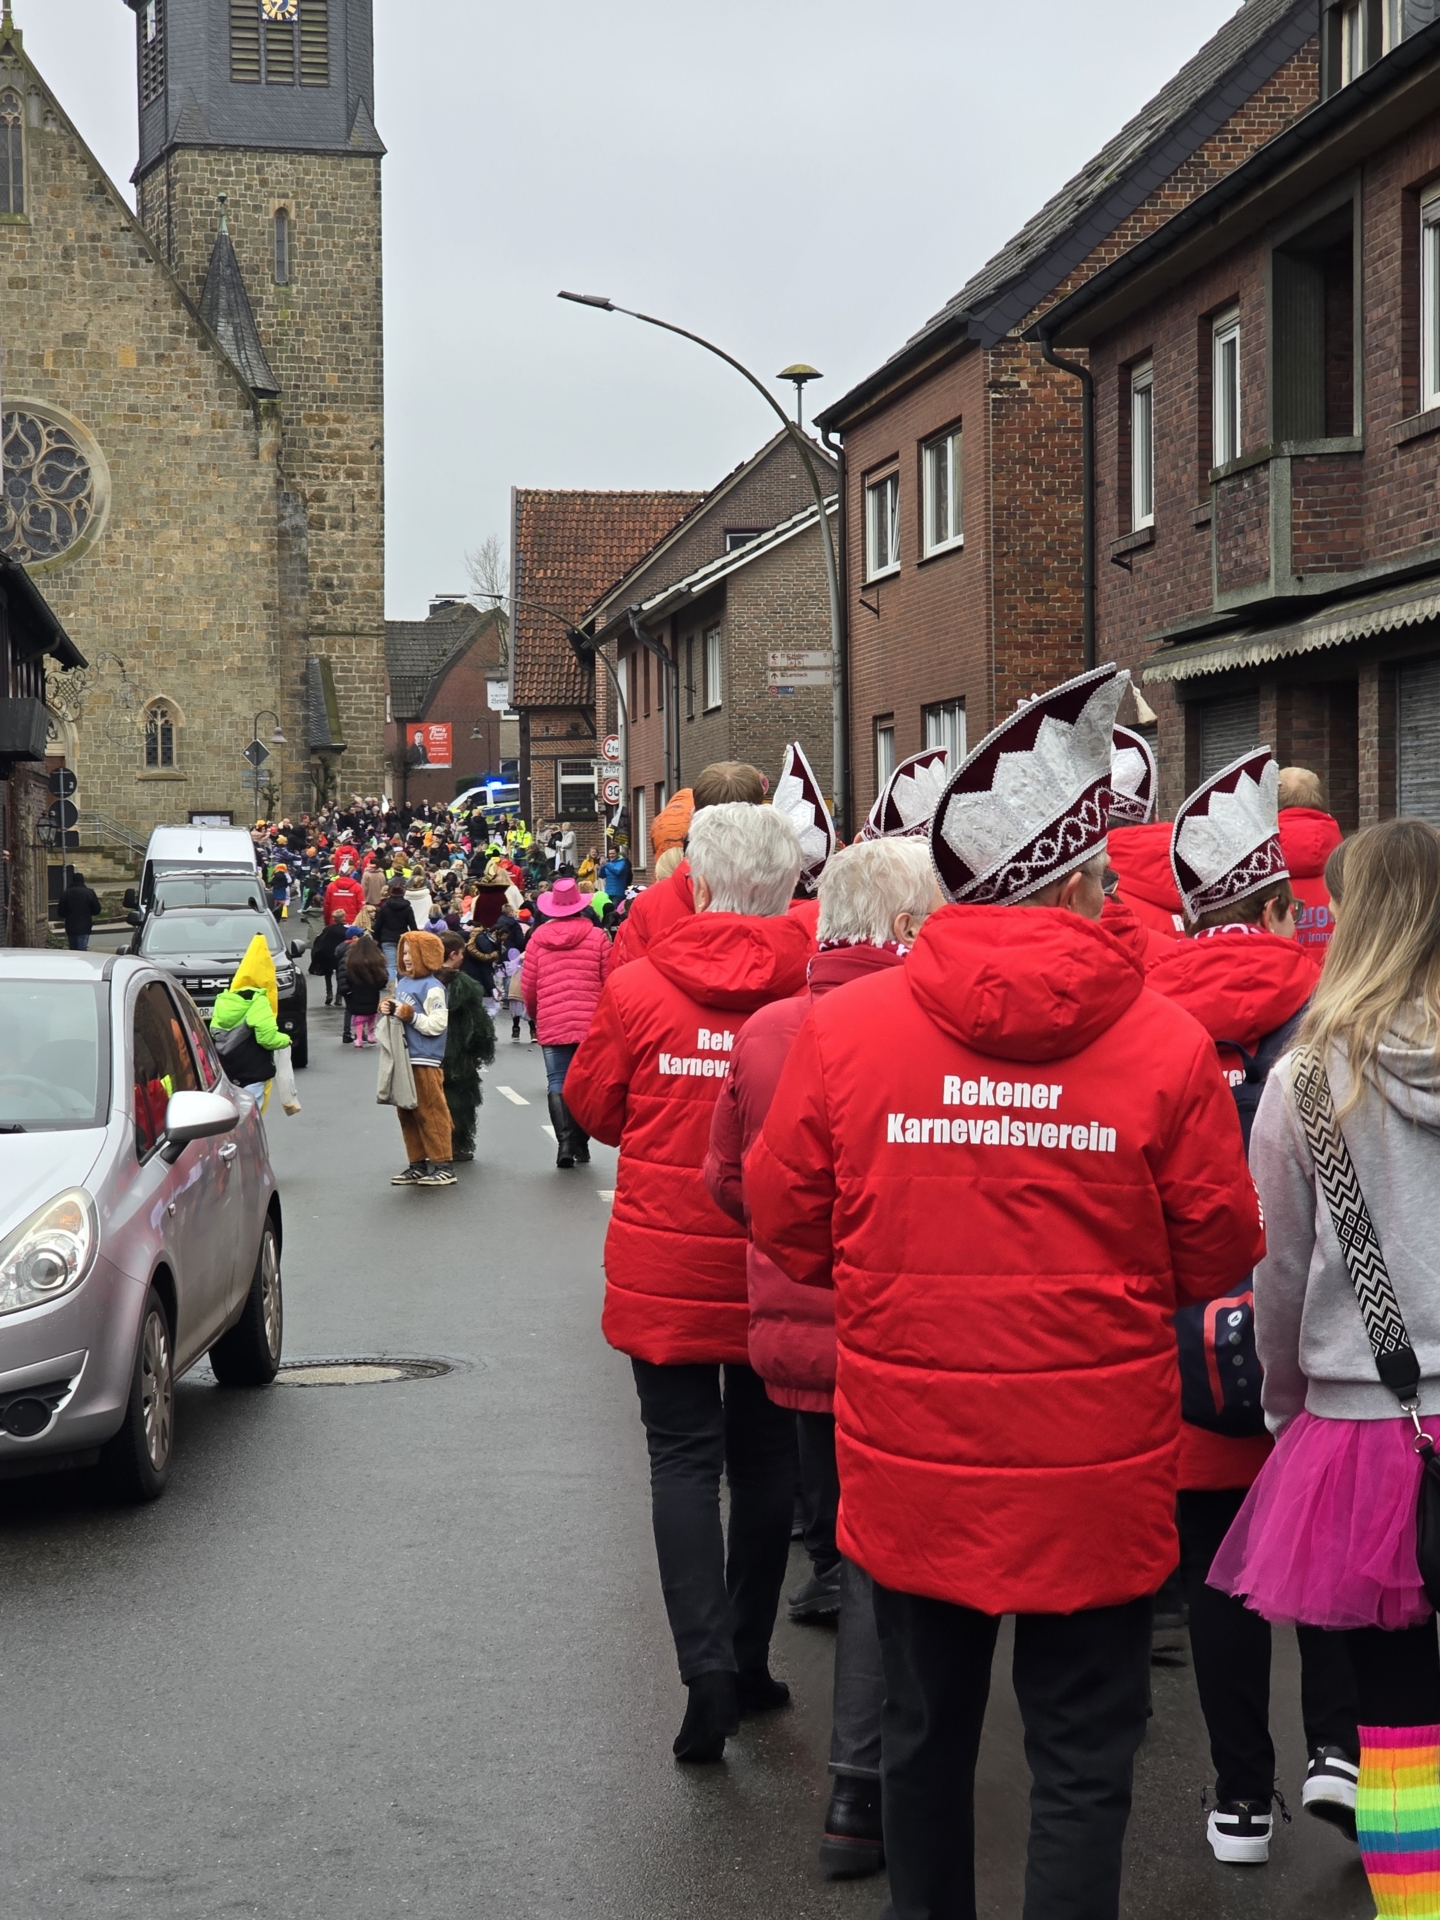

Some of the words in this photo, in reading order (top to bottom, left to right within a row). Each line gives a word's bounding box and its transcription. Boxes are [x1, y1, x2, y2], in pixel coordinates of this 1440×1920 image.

[607, 785, 619, 797] 30
[199, 1008, 210, 1017] OR
[697, 1028, 735, 1052] Rek
[658, 1053, 730, 1078] Karnev
[942, 1074, 1063, 1110] Rekener
[886, 1113, 1117, 1153] Karnevalsverein
